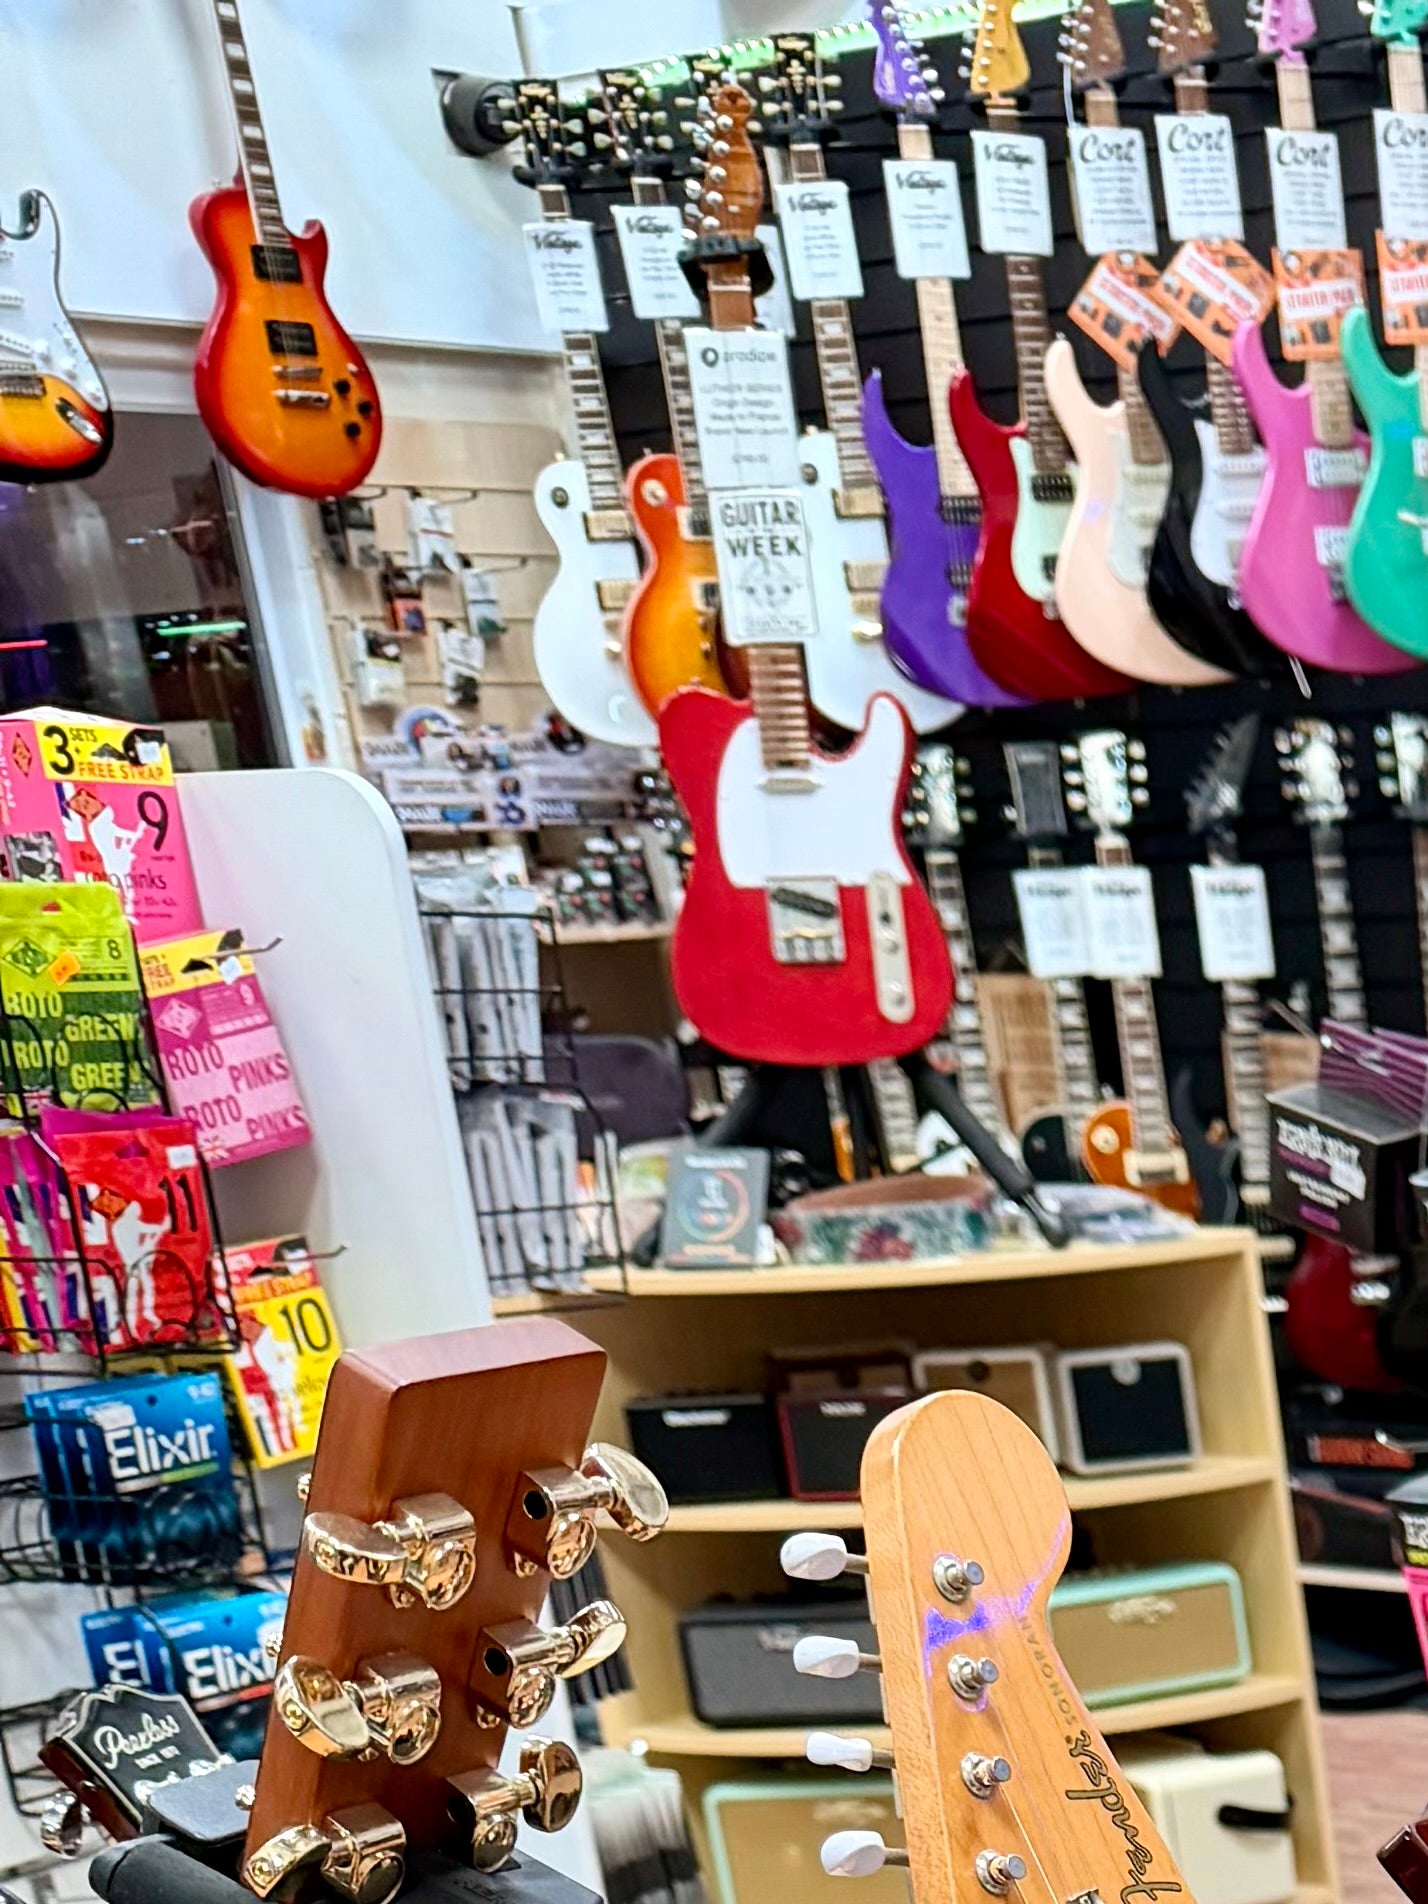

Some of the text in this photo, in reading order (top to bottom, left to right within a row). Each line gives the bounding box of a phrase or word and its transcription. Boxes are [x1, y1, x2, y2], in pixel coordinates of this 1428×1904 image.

[1079, 133, 1136, 164] Cort
[1168, 123, 1227, 153] Cort
[1276, 137, 1331, 168] Cort
[719, 500, 801, 529] GUITAR
[726, 534, 804, 559] WEEK
[43, 724, 98, 776] 3 SETS
[78, 761, 165, 782] FREE STRAP
[137, 790, 169, 852] 9
[108, 938, 122, 960] 8
[4, 991, 63, 1018] ROTO
[65, 1012, 146, 1042] GREEN
[15, 1040, 70, 1069] ROTO
[166, 1040, 225, 1082] ROTO
[228, 1052, 290, 1095] PINKS
[183, 1094, 243, 1132] ROTO
[247, 1104, 306, 1140] PINKS
[159, 1173, 198, 1236] 11
[280, 1296, 332, 1357] 10
[104, 1418, 215, 1480] Elixir
[183, 1641, 277, 1699] Elixi
[1017, 1616, 1078, 1727] SONORAN
[94, 1711, 181, 1771] Peerless
